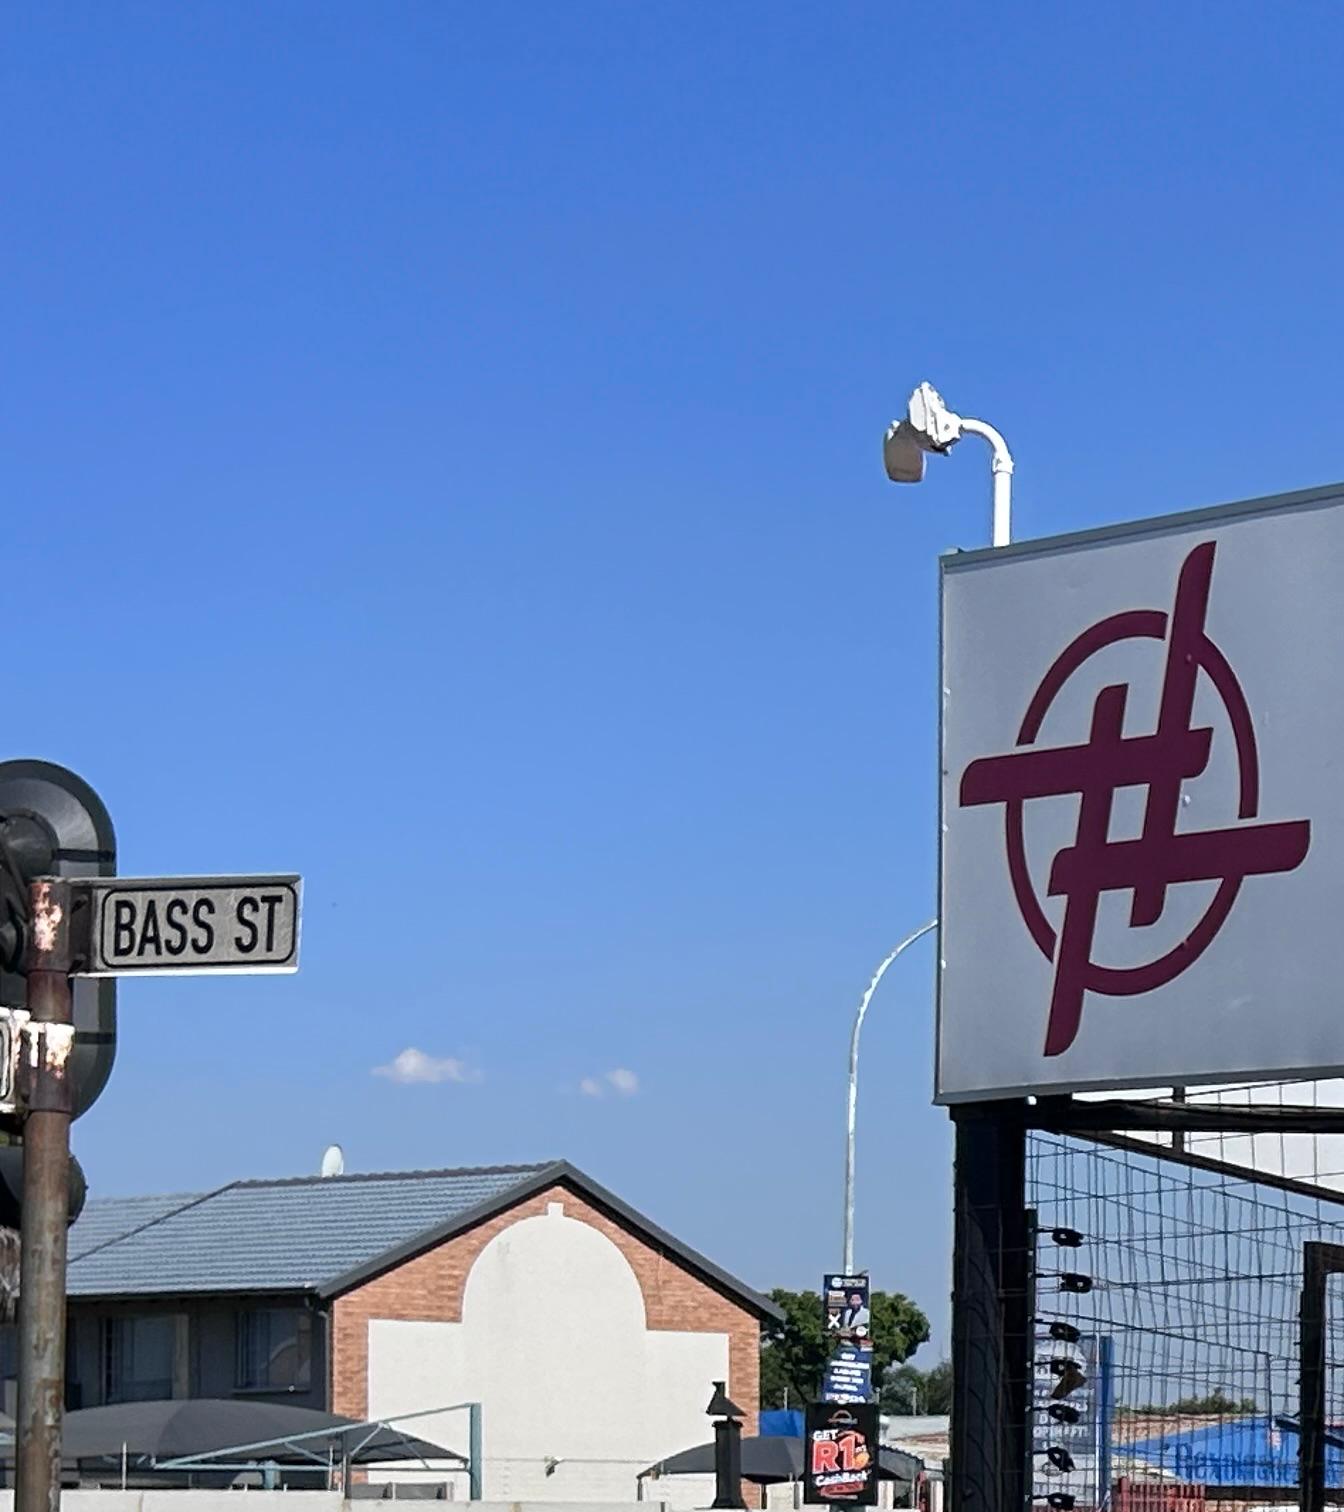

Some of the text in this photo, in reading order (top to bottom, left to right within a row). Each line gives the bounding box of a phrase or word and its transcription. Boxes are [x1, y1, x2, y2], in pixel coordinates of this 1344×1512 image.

[113, 895, 283, 957] BASS ST
[813, 1429, 838, 1441] GET
